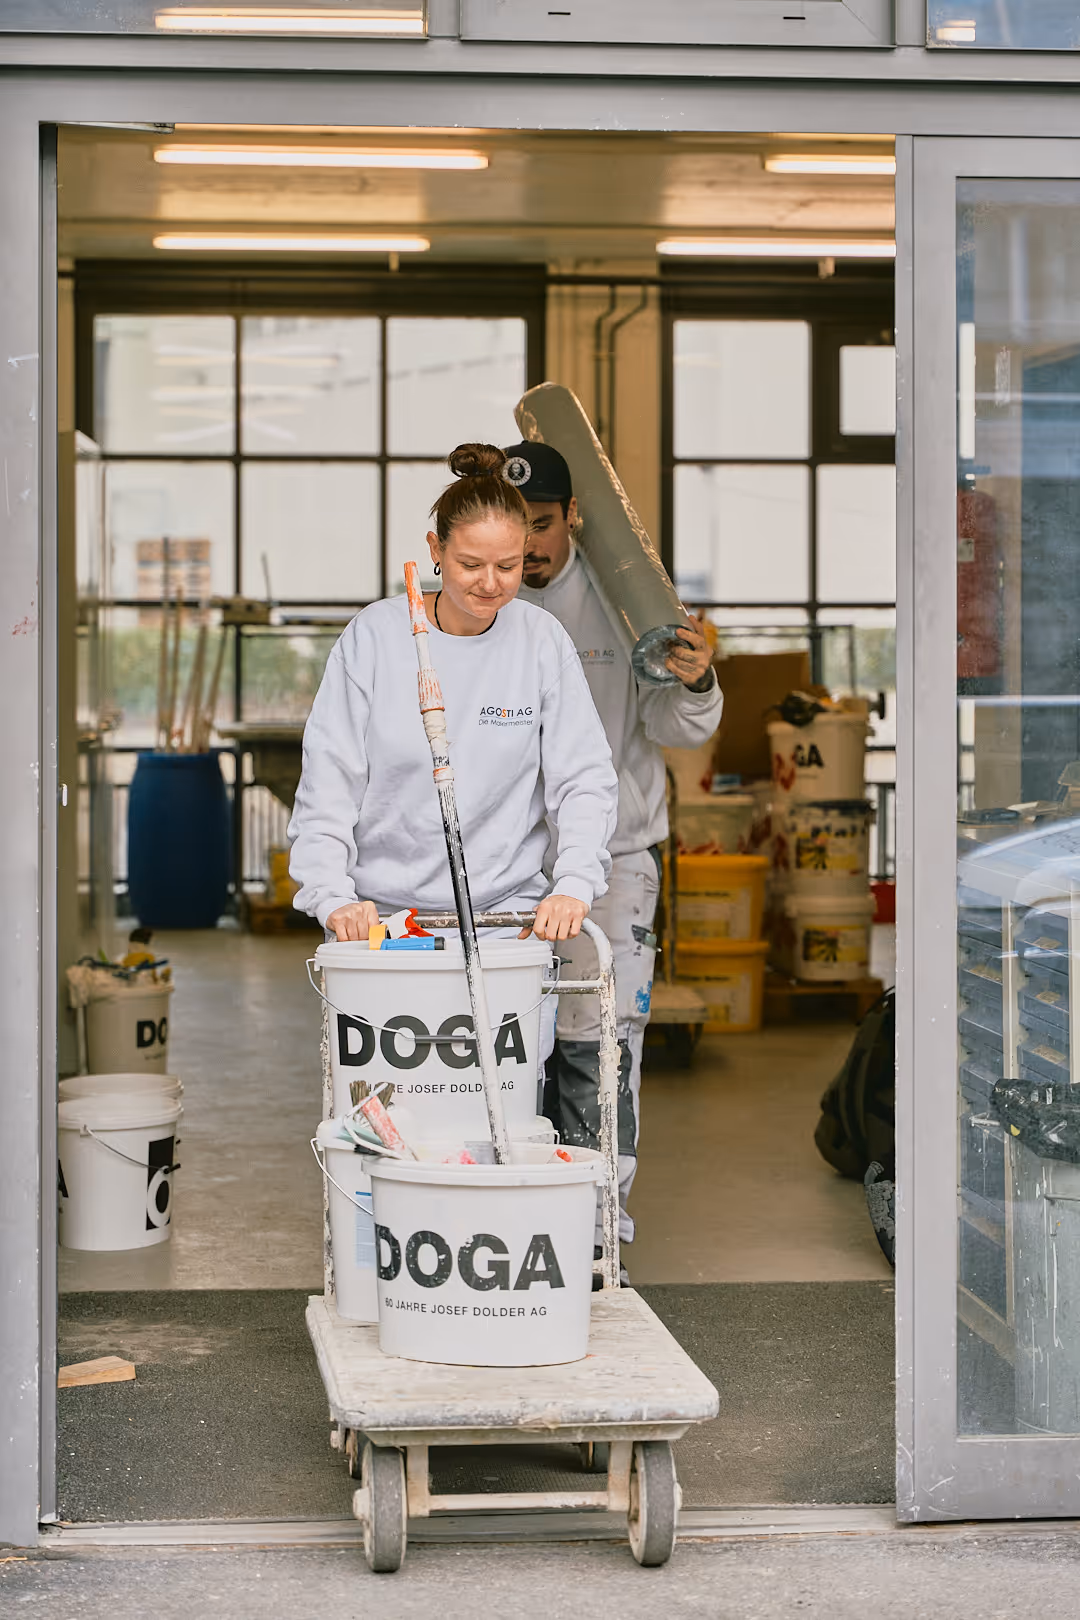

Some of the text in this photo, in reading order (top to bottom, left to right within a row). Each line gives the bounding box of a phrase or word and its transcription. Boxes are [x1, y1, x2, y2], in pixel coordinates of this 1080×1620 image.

[577, 649, 615, 658] OSTI AG
[479, 706, 533, 718] AGOSTI AG
[336, 1012, 528, 1070] DOGA
[407, 1084, 446, 1094] JOSEF
[450, 1083, 484, 1093] DOLD
[500, 1081, 514, 1091] AG
[374, 1223, 566, 1292] DOGA
[395, 1299, 427, 1313] JAHRE
[430, 1304, 469, 1316] JOSEF
[472, 1306, 526, 1317] DOLDER
[530, 1306, 547, 1317] AG
